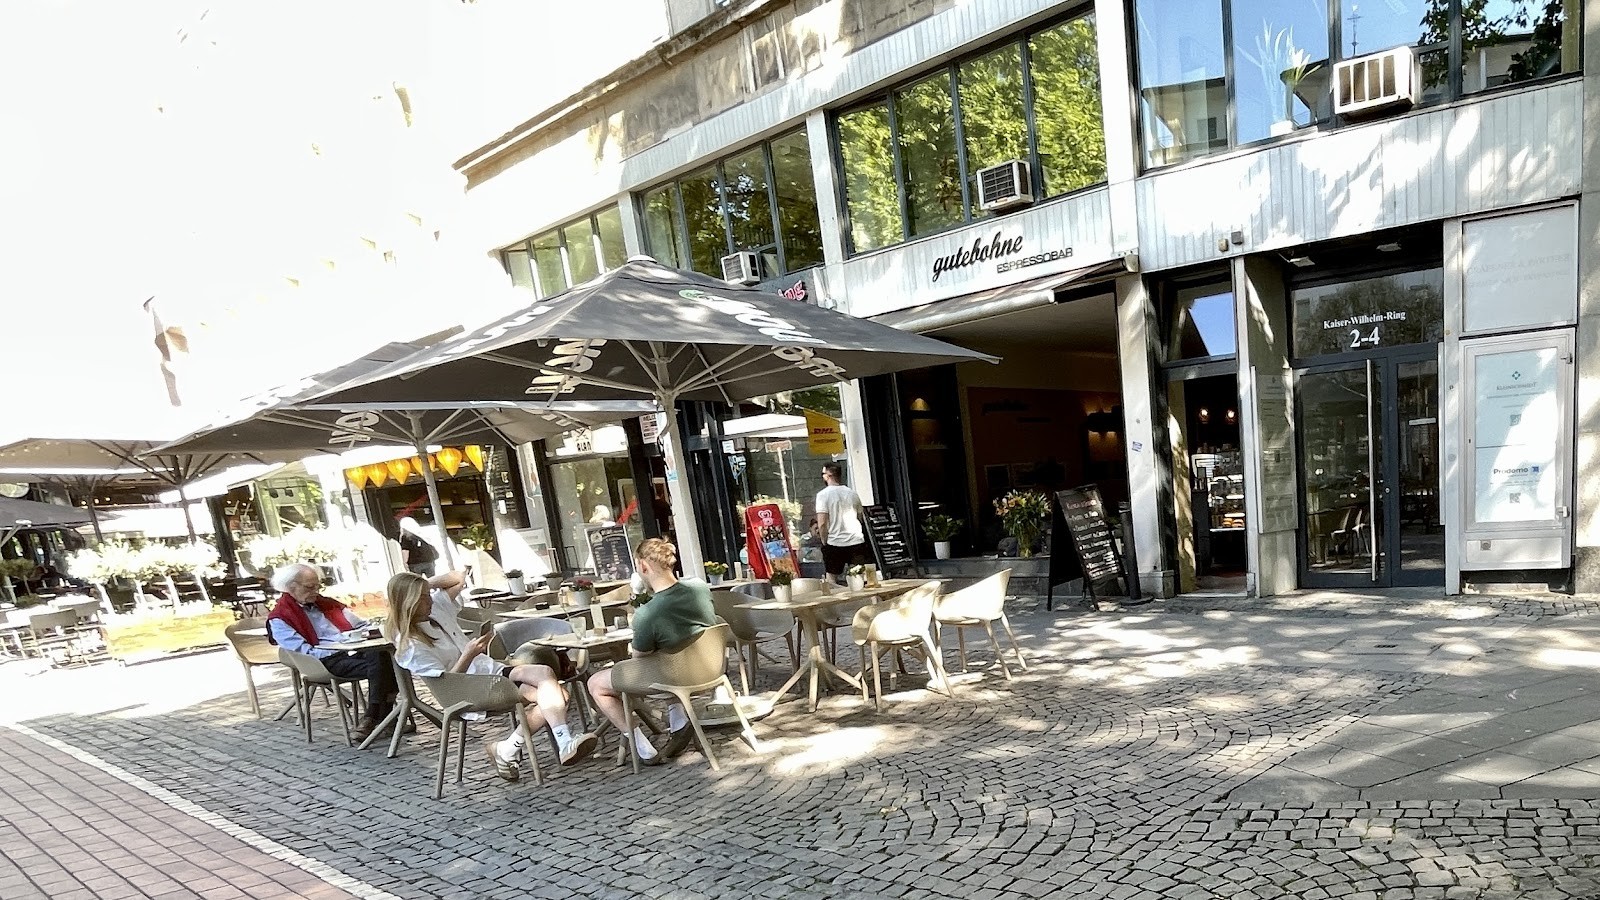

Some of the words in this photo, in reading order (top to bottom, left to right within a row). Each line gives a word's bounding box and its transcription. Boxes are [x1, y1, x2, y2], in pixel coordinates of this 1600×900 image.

[932, 231, 1023, 282] gutebohne
[996, 247, 1073, 274] ESPRESSOBAR
[1323, 311, 1406, 330] Kaiser-Wilhelm-Ring
[1349, 326, 1380, 348] 2-4
[812, 427, 836, 435] DHL
[1493, 466, 1529, 475] Prodomo
